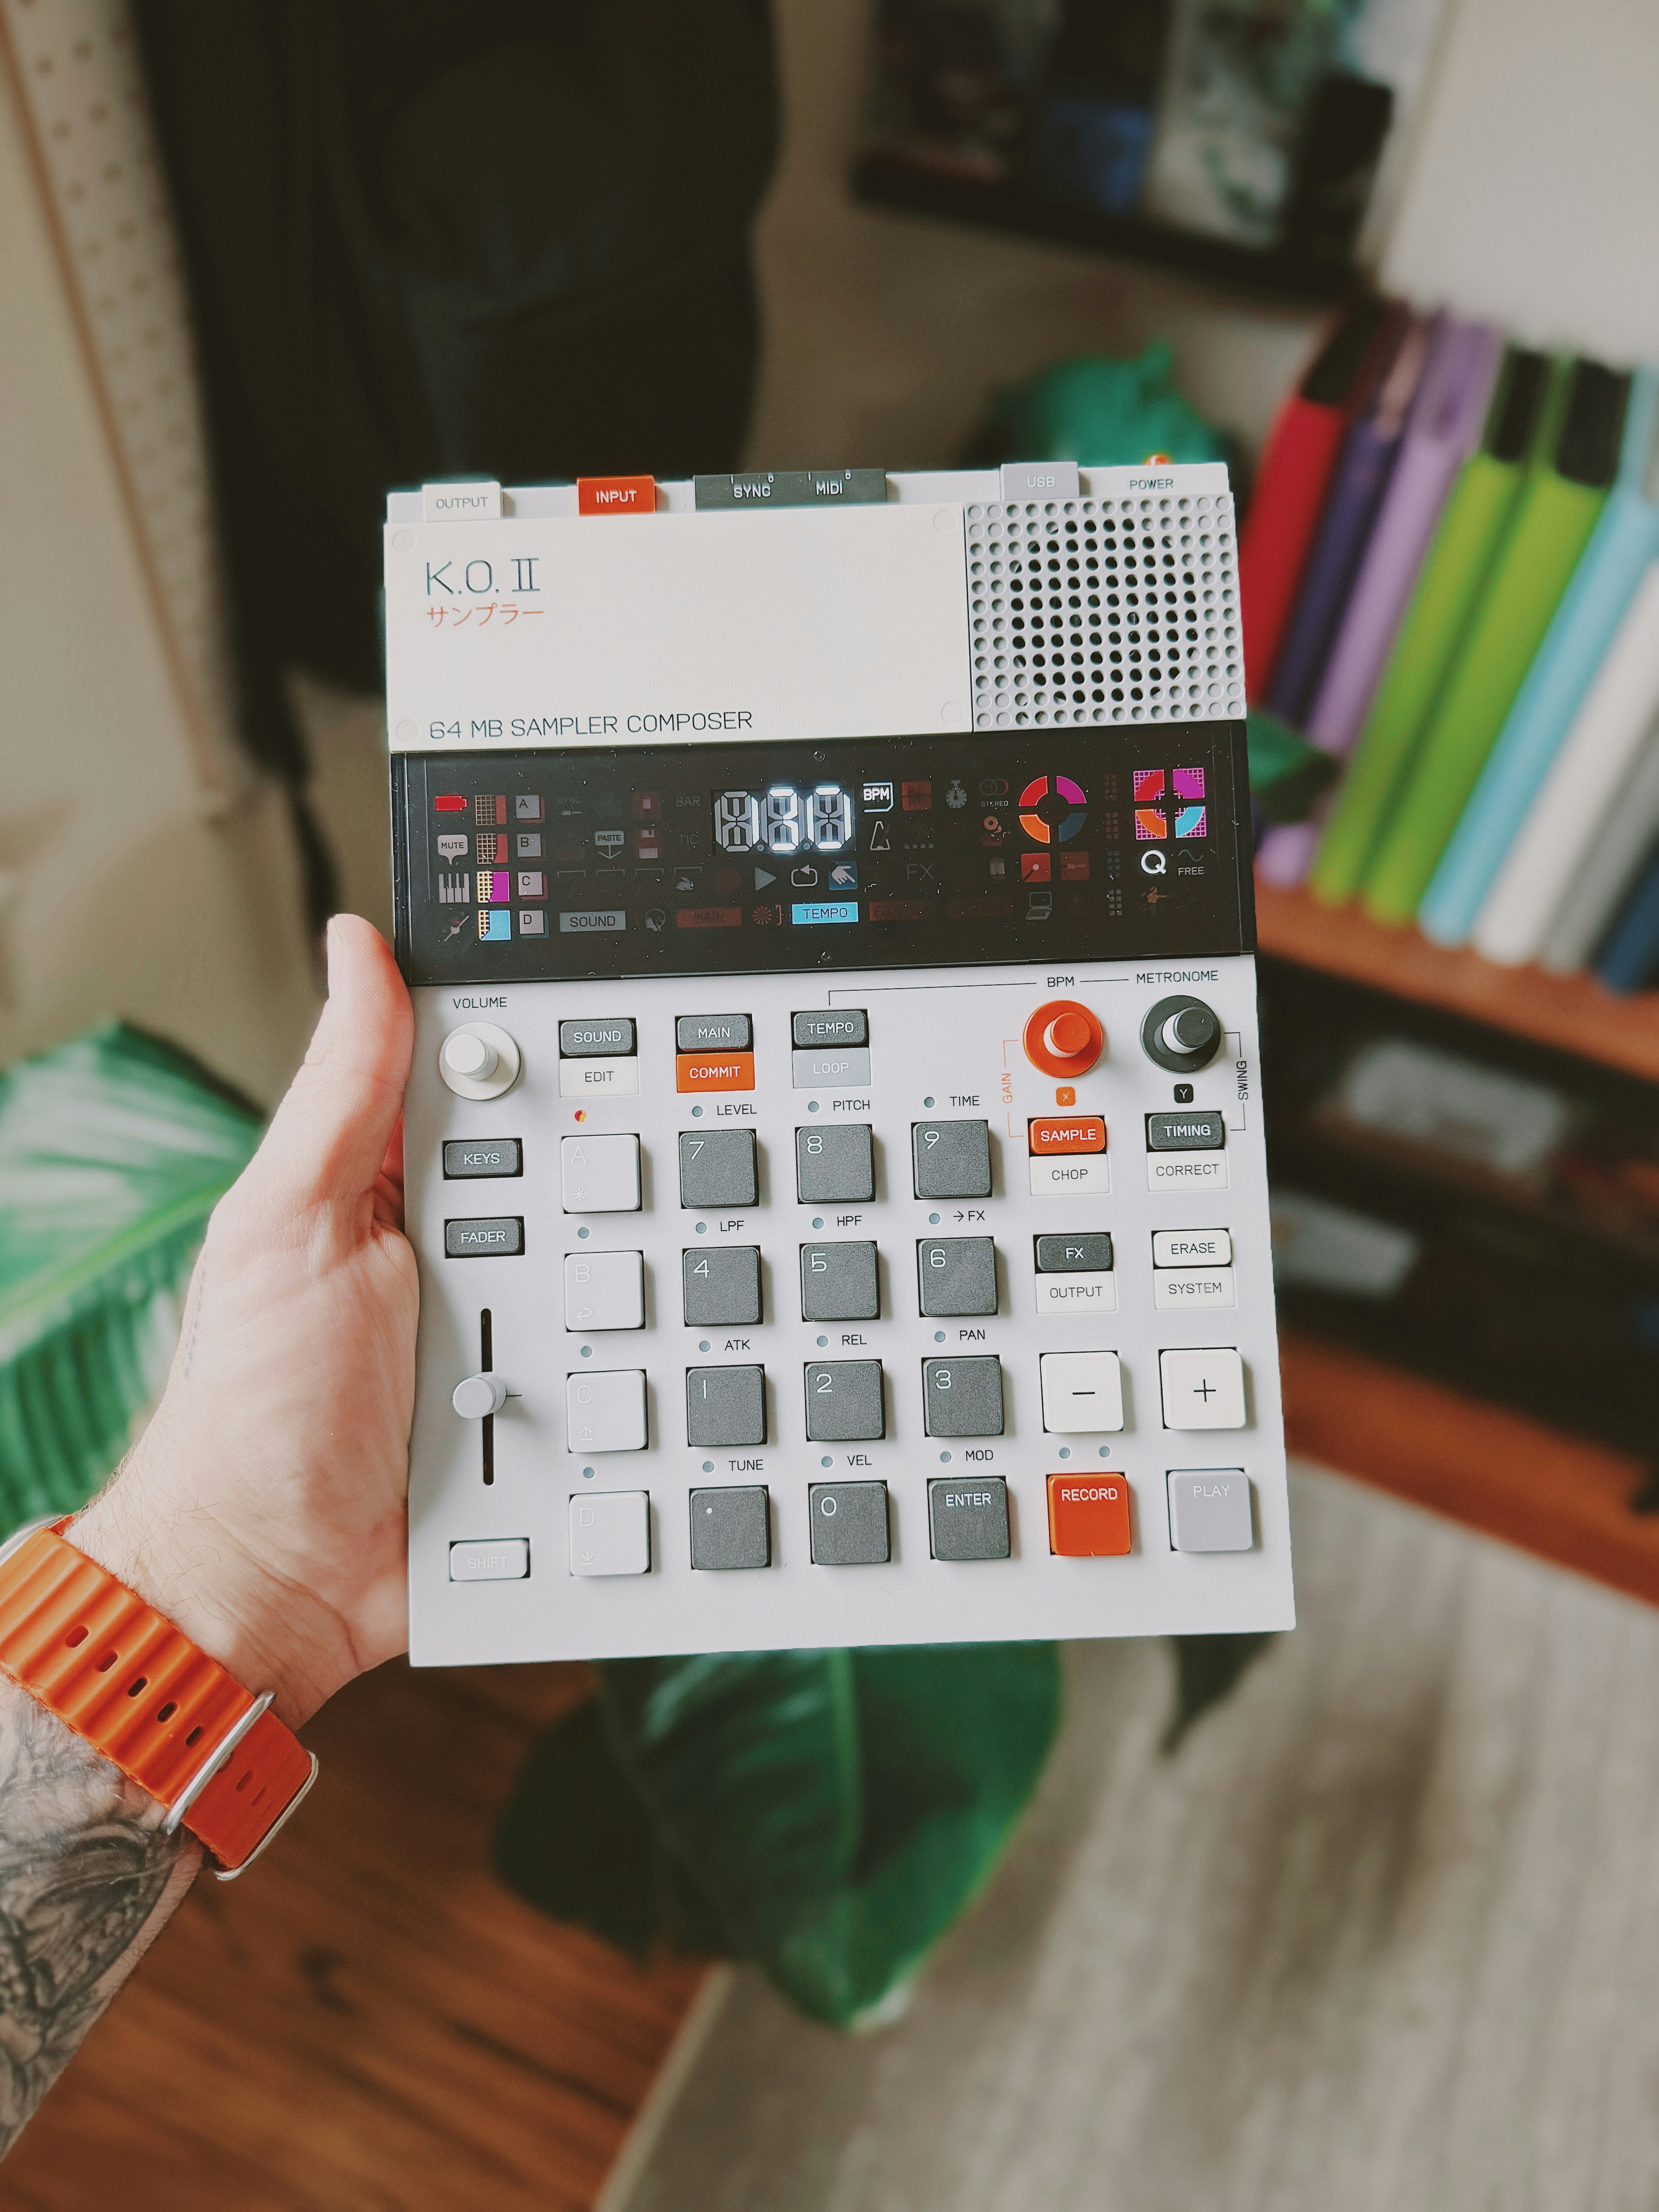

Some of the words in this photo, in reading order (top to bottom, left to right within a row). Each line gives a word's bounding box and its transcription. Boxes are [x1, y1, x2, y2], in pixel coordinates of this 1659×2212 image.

[816, 481, 842, 495] MIDI
[1027, 477, 1054, 488] USB
[1130, 479, 1173, 489] POWER
[596, 490, 637, 503] INPUT
[734, 485, 771, 498] SYNC
[436, 497, 488, 508] OUTPUT
[427, 602, 543, 627] サンプラー
[430, 721, 461, 738] 64
[472, 720, 502, 737] MB
[512, 716, 617, 736] SAMPLER
[628, 711, 752, 732] COMPOSER
[864, 788, 890, 801] BPM
[519, 799, 528, 809] A
[676, 796, 701, 807] BAR
[520, 837, 529, 847] B
[1141, 850, 1166, 874] Q
[907, 863, 934, 881] FX
[1178, 867, 1205, 876] FREE
[522, 876, 530, 886] C
[524, 915, 531, 924] D
[803, 908, 847, 919] TEMPO
[570, 916, 615, 927] SOUND
[1048, 977, 1074, 987] BPM
[1137, 970, 1218, 983] METRONOME
[453, 997, 507, 1008] VOLUME
[699, 1027, 730, 1039] MAIN
[807, 1022, 853, 1034] TEMPO
[574, 1031, 621, 1043] SOUND
[690, 1066, 740, 1078] COMMIT
[814, 1063, 848, 1073] LOOP
[585, 1071, 613, 1082] EDIT
[1237, 1061, 1248, 1099] SWING
[1001, 1073, 1012, 1103] GAIN
[1180, 1089, 1187, 1098] Y
[833, 1100, 870, 1111] PITCH
[950, 1096, 979, 1106] TIME
[717, 1104, 757, 1115] LEVEL
[1041, 1129, 1096, 1141] SAMPLE
[1164, 1125, 1210, 1137] TIMING
[807, 1135, 822, 1154] 8
[924, 1132, 939, 1149] 9
[570, 1146, 587, 1164] A
[689, 1140, 704, 1159] 7
[465, 1152, 500, 1164] KEYS
[1052, 1169, 1088, 1180] CHOP
[1156, 1164, 1219, 1176] CORRECT
[837, 1216, 862, 1226] HPF
[969, 1211, 984, 1221] FX
[721, 1221, 744, 1231] LPF
[462, 1231, 506, 1243] FADER
[1066, 1248, 1084, 1259] FX
[1171, 1243, 1215, 1254] ERASE
[811, 1252, 827, 1271] 5
[929, 1249, 945, 1267] 6
[575, 1264, 591, 1283] B
[694, 1260, 709, 1278] 4
[1050, 1286, 1102, 1298] OUTPUT
[1169, 1283, 1221, 1294] SYSTEM
[842, 1334, 867, 1345] REL
[960, 1330, 985, 1340] PAN
[725, 1340, 750, 1350] ATK
[817, 1374, 832, 1393] 2
[936, 1370, 951, 1389] 3
[577, 1385, 592, 1404] C
[847, 1455, 872, 1465] VEL
[966, 1450, 993, 1461] MOD
[729, 1460, 763, 1471] TUNE
[1061, 1488, 1118, 1501] RECORD
[1193, 1485, 1230, 1498] PLAY
[946, 1492, 991, 1507] ENTER
[580, 1507, 595, 1527] D
[468, 1556, 508, 1570] SHIFT
